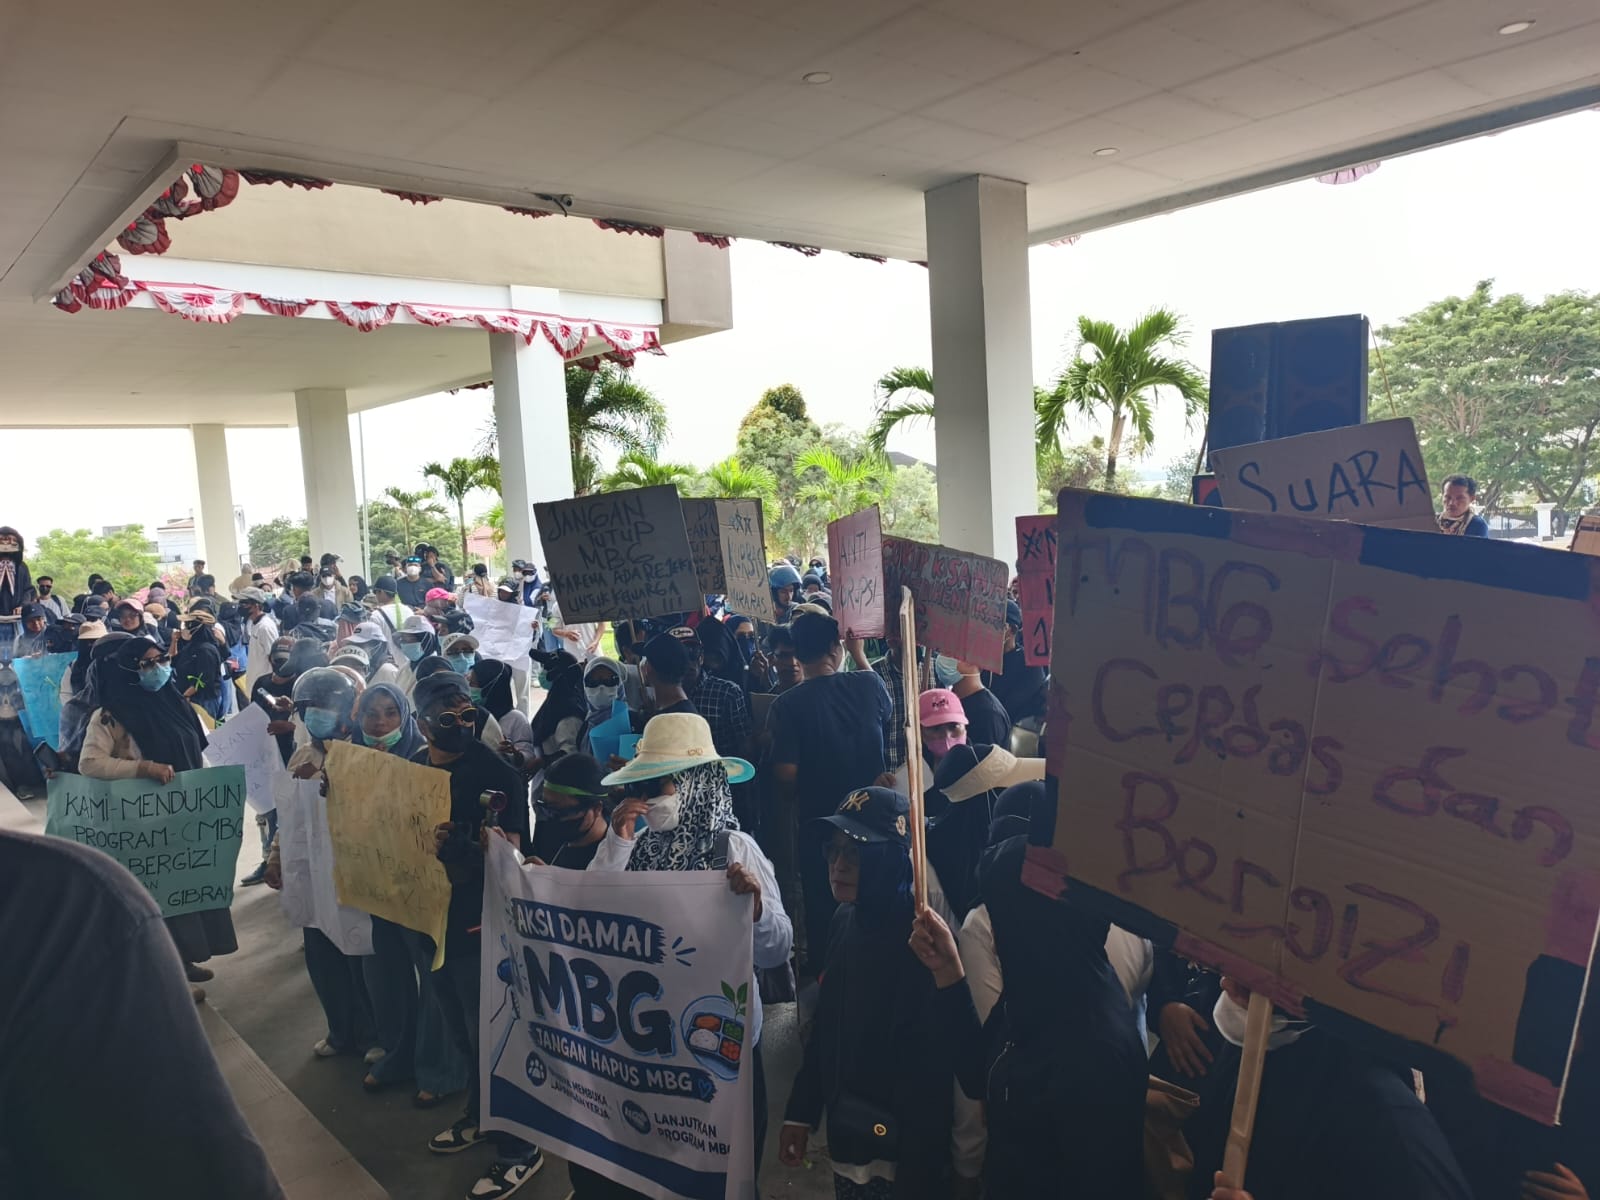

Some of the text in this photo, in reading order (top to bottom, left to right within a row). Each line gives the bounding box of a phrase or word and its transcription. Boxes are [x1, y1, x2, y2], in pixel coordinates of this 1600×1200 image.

[1238, 449, 1427, 513] SUARA
[547, 495, 645, 543] JANGAN
[586, 521, 655, 548] TUTUP
[578, 542, 655, 571] MBG
[552, 572, 608, 596] KARENA
[614, 567, 642, 585] ADA
[568, 590, 610, 613] UNTUK
[73, 825, 168, 850] PROGRAM
[129, 844, 217, 876] BERGIZI
[516, 906, 652, 957] AKSI DAMAI
[522, 945, 677, 1058] MBG
[536, 1027, 587, 1065] JANGAN
[592, 1053, 640, 1087] HAPUS
[647, 1070, 693, 1092] MBG
[654, 1112, 717, 1138] LANJUTKAN
[657, 1127, 705, 1151] PROGRAM
